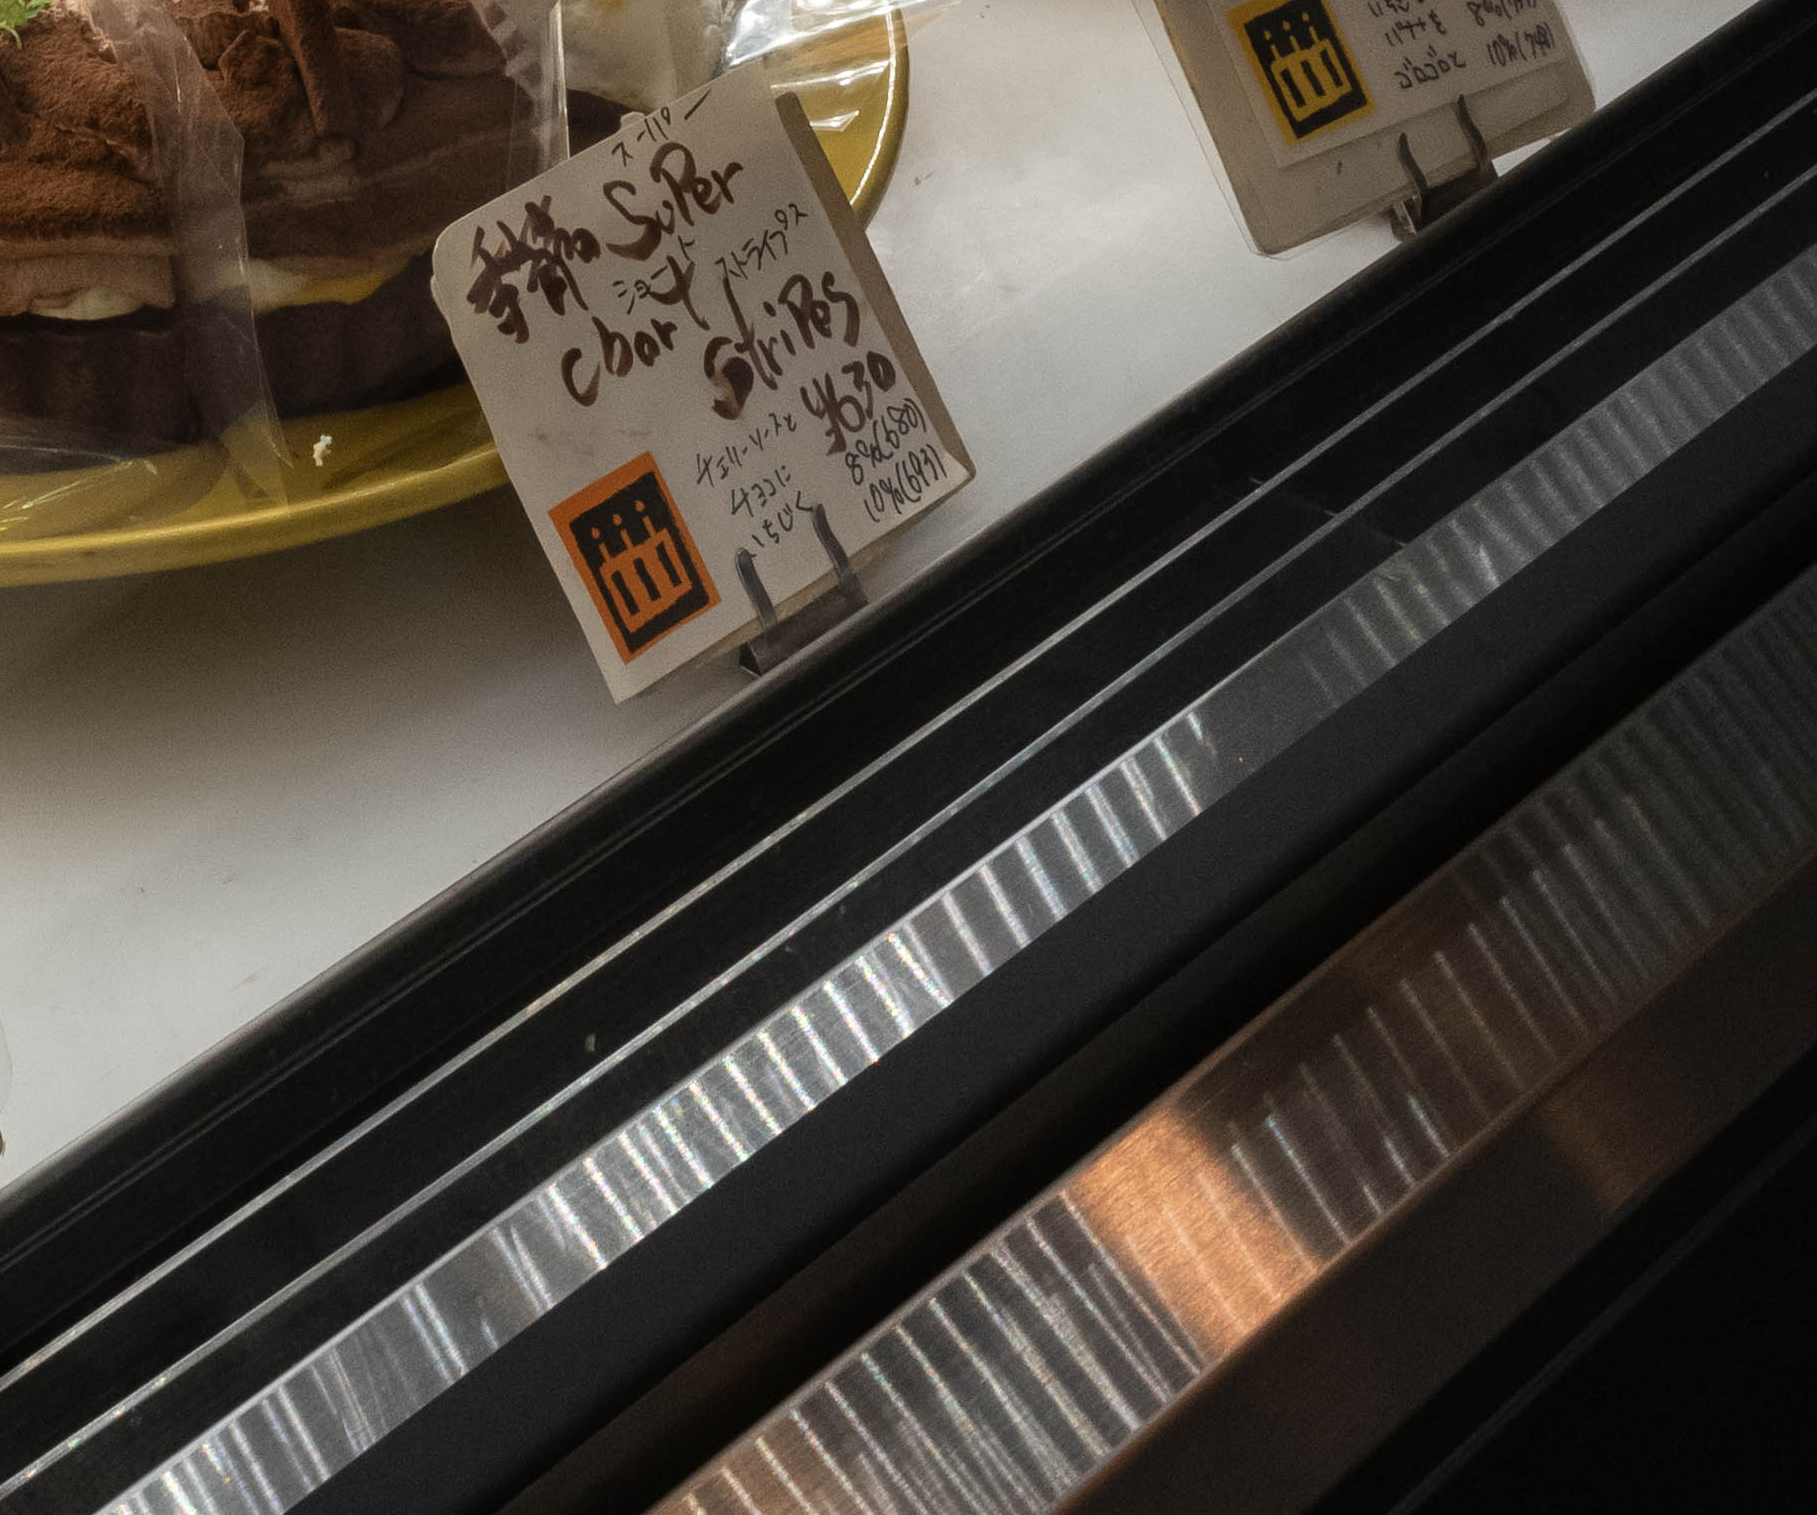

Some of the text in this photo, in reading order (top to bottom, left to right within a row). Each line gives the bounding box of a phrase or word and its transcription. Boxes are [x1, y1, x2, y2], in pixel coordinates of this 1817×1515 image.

[714, 202, 810, 281] ストライプス
[799, 350, 896, 456] ¥630
